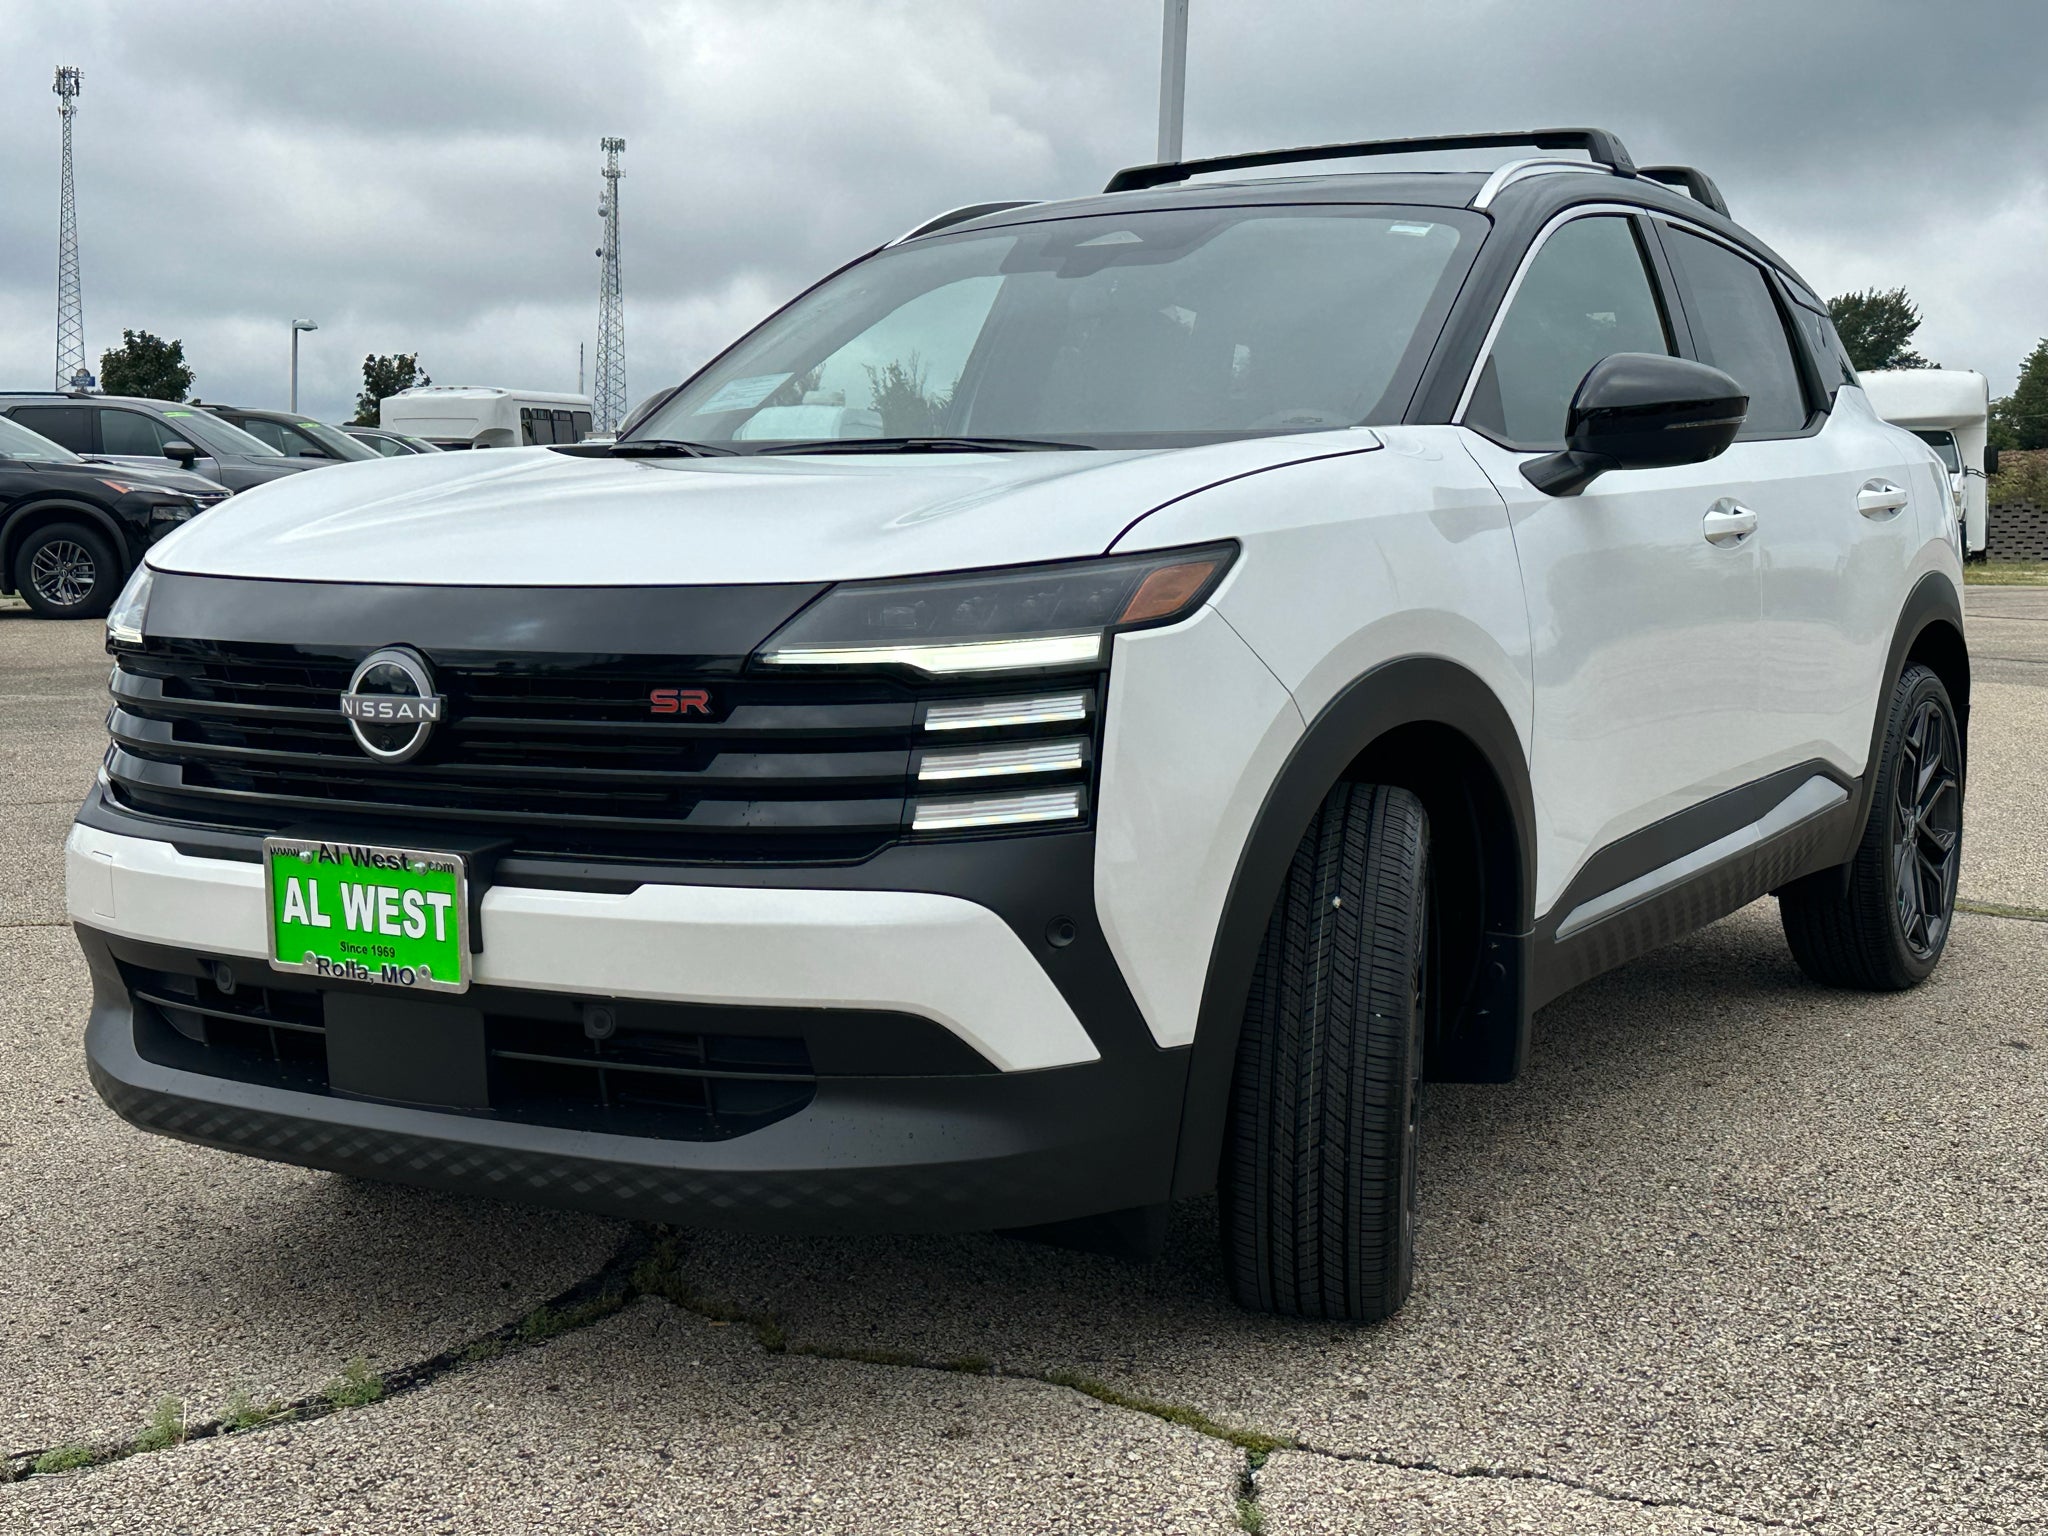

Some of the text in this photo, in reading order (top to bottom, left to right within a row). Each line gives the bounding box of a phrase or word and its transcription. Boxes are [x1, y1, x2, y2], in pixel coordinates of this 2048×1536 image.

[341, 697, 438, 719] NISSAN
[650, 688, 710, 714] SR
[319, 843, 341, 865] Al
[347, 845, 411, 873] West
[283, 876, 452, 942] AL WEST
[339, 941, 396, 959] Since 1969
[317, 956, 416, 986] Rolla, MO
